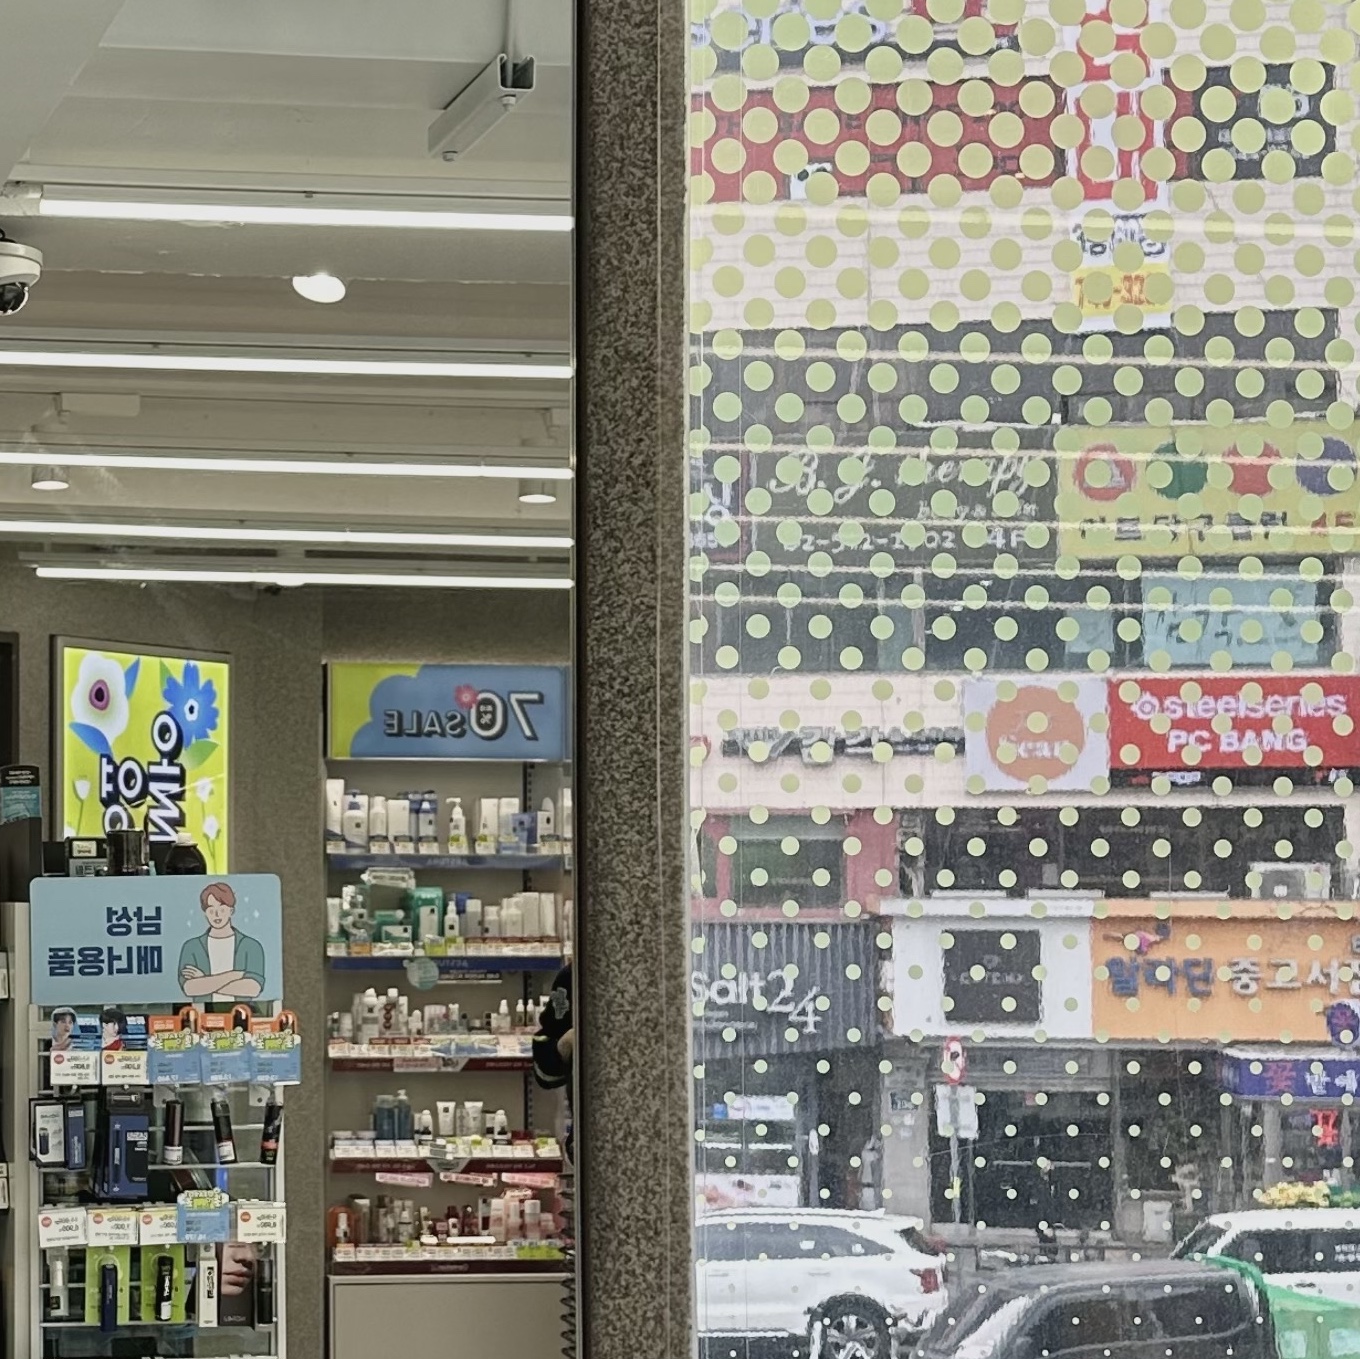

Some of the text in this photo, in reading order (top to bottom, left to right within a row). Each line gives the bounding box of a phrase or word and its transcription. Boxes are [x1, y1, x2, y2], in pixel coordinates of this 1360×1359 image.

[1166, 729, 1308, 758] PC BANG
[1103, 956, 1211, 999] 알라딘
